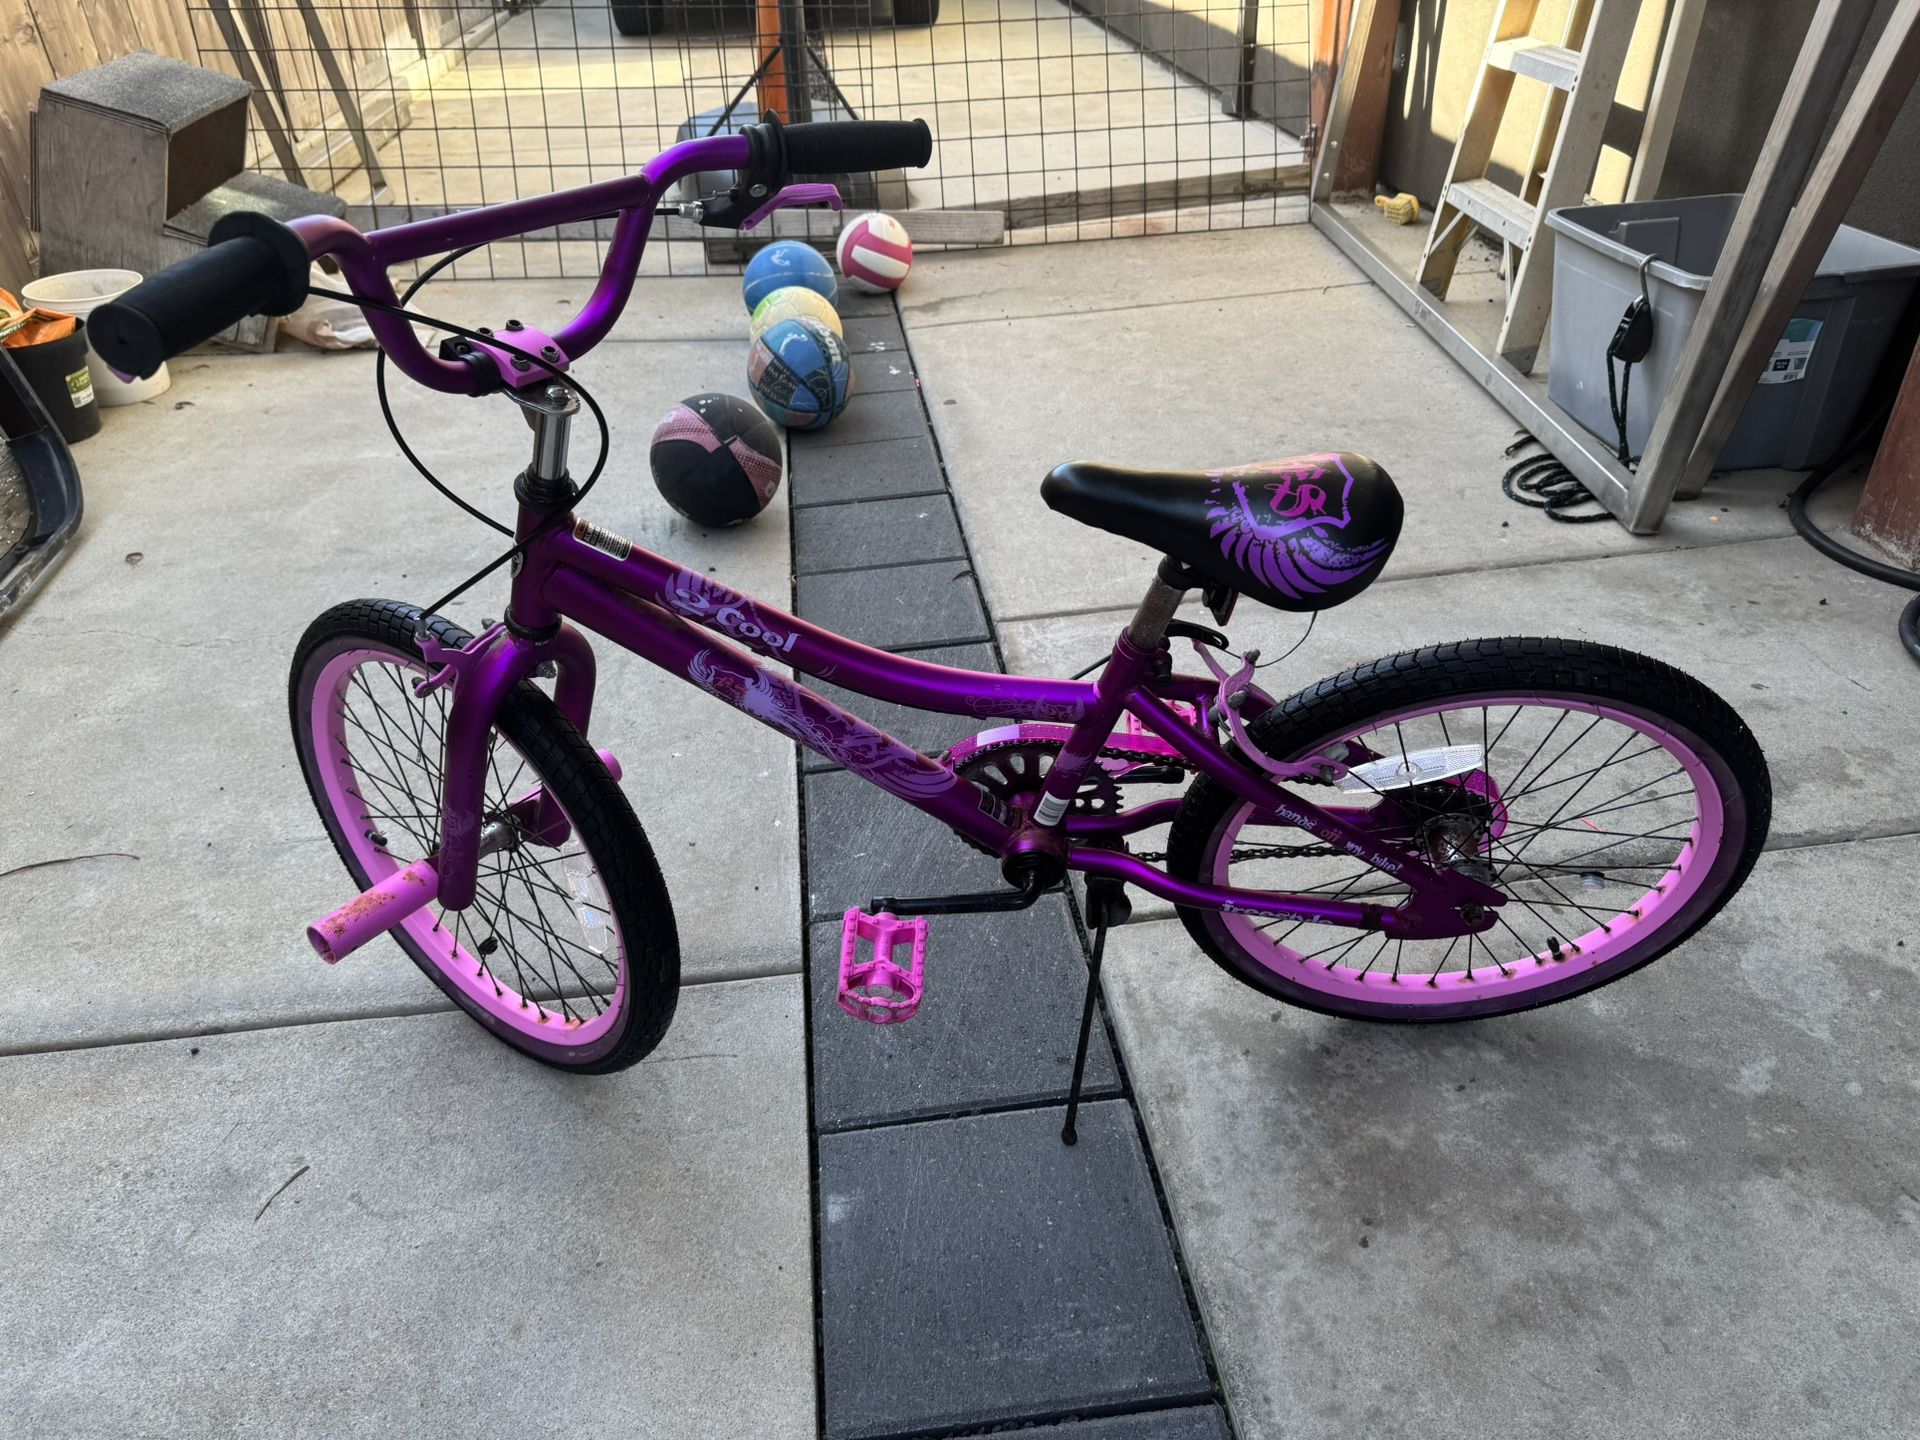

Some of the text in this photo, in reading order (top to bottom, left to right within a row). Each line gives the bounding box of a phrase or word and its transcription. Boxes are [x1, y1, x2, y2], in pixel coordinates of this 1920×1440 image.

[669, 588, 802, 653] 2 Cool
[1274, 804, 1318, 830] hands
